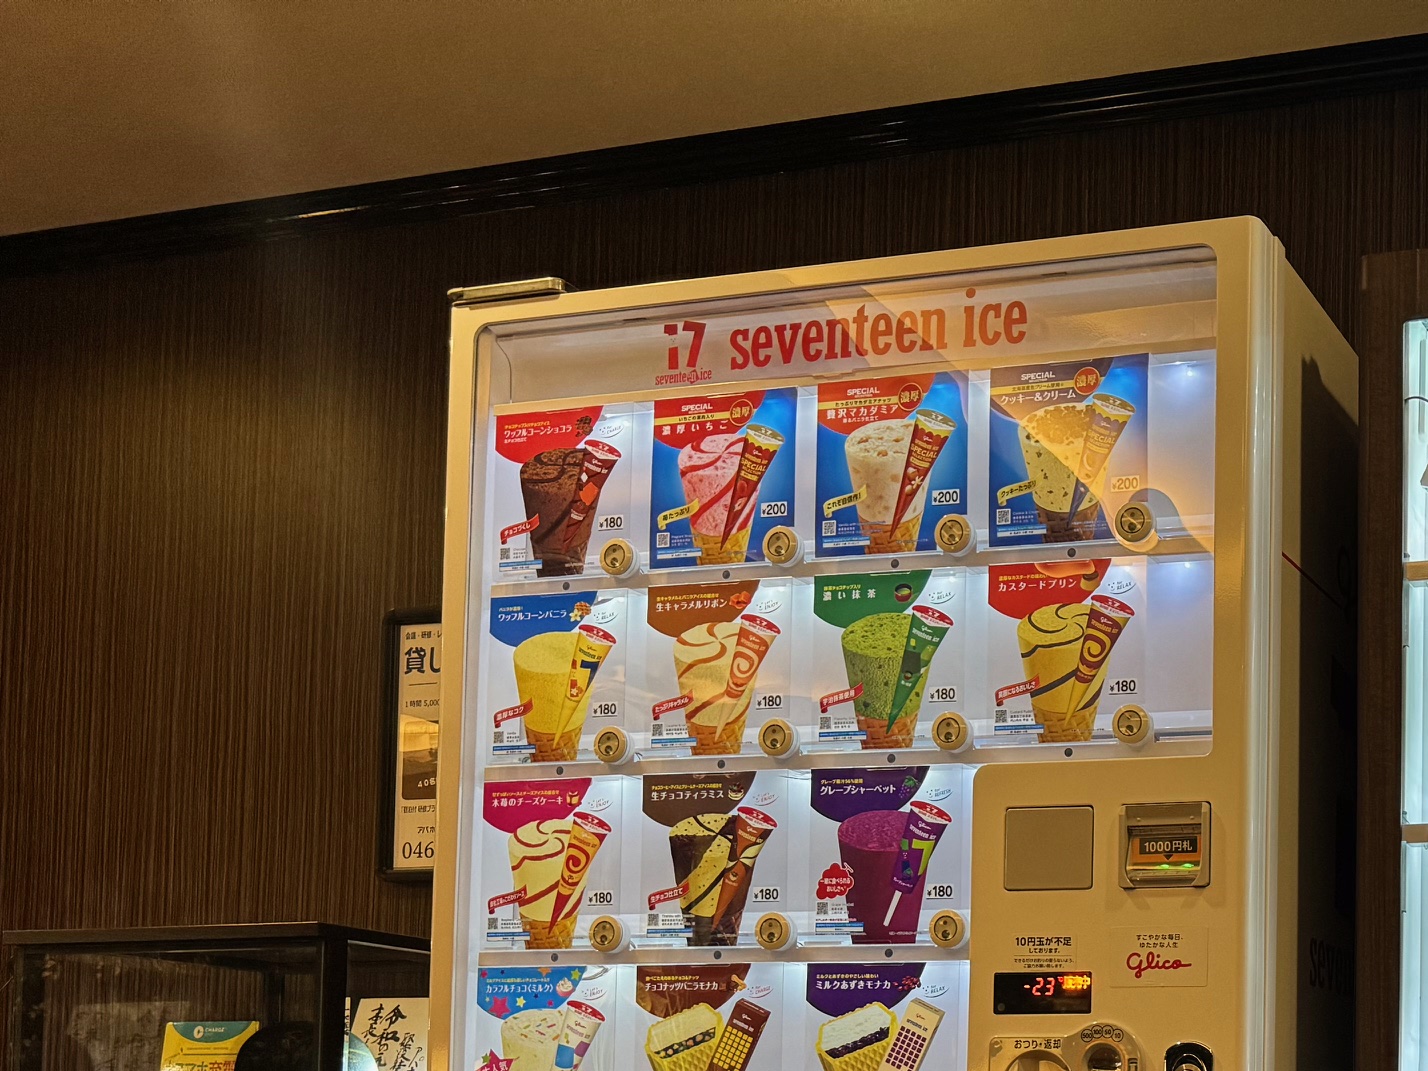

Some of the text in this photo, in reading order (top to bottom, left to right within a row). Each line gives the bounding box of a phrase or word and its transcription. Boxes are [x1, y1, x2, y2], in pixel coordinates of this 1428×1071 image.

[730, 288, 1028, 371] seventeen ice
[1021, 372, 1056, 380] SPECIAL
[1077, 374, 1098, 387] 濃厚
[1001, 390, 1076, 405] クッキー&クリーム
[827, 404, 899, 419] 贅沢マカダミア
[504, 424, 572, 437] ワッフルコーンショコラ
[662, 420, 728, 435] 濃厚いちご
[933, 490, 960, 504] ¥200
[762, 503, 786, 515] ¥200
[599, 517, 623, 530] ¥180
[998, 578, 1077, 592] カスタードプリン
[823, 589, 876, 602] 濃い抹茶
[656, 599, 728, 612] 生キャラメルリボン
[498, 609, 568, 621] ワッフルコーンバニラ
[757, 695, 782, 708] ¥180
[593, 703, 617, 715] ¥180
[651, 790, 724, 801] 生チョコティラミス
[820, 784, 897, 796] グレープシャーベット
[492, 796, 563, 807] 木苺のチーズケーキ
[402, 841, 435, 859] 046
[1143, 839, 1193, 853] 1000円札
[1016, 936, 1072, 946] 10円玉が不足
[1126, 952, 1192, 978] Glico
[645, 981, 719, 992] チョコナッツバニラモナカ
[816, 979, 891, 990] ミルクあずきモナカ
[1014, 1039, 1061, 1049] おつり・返却
